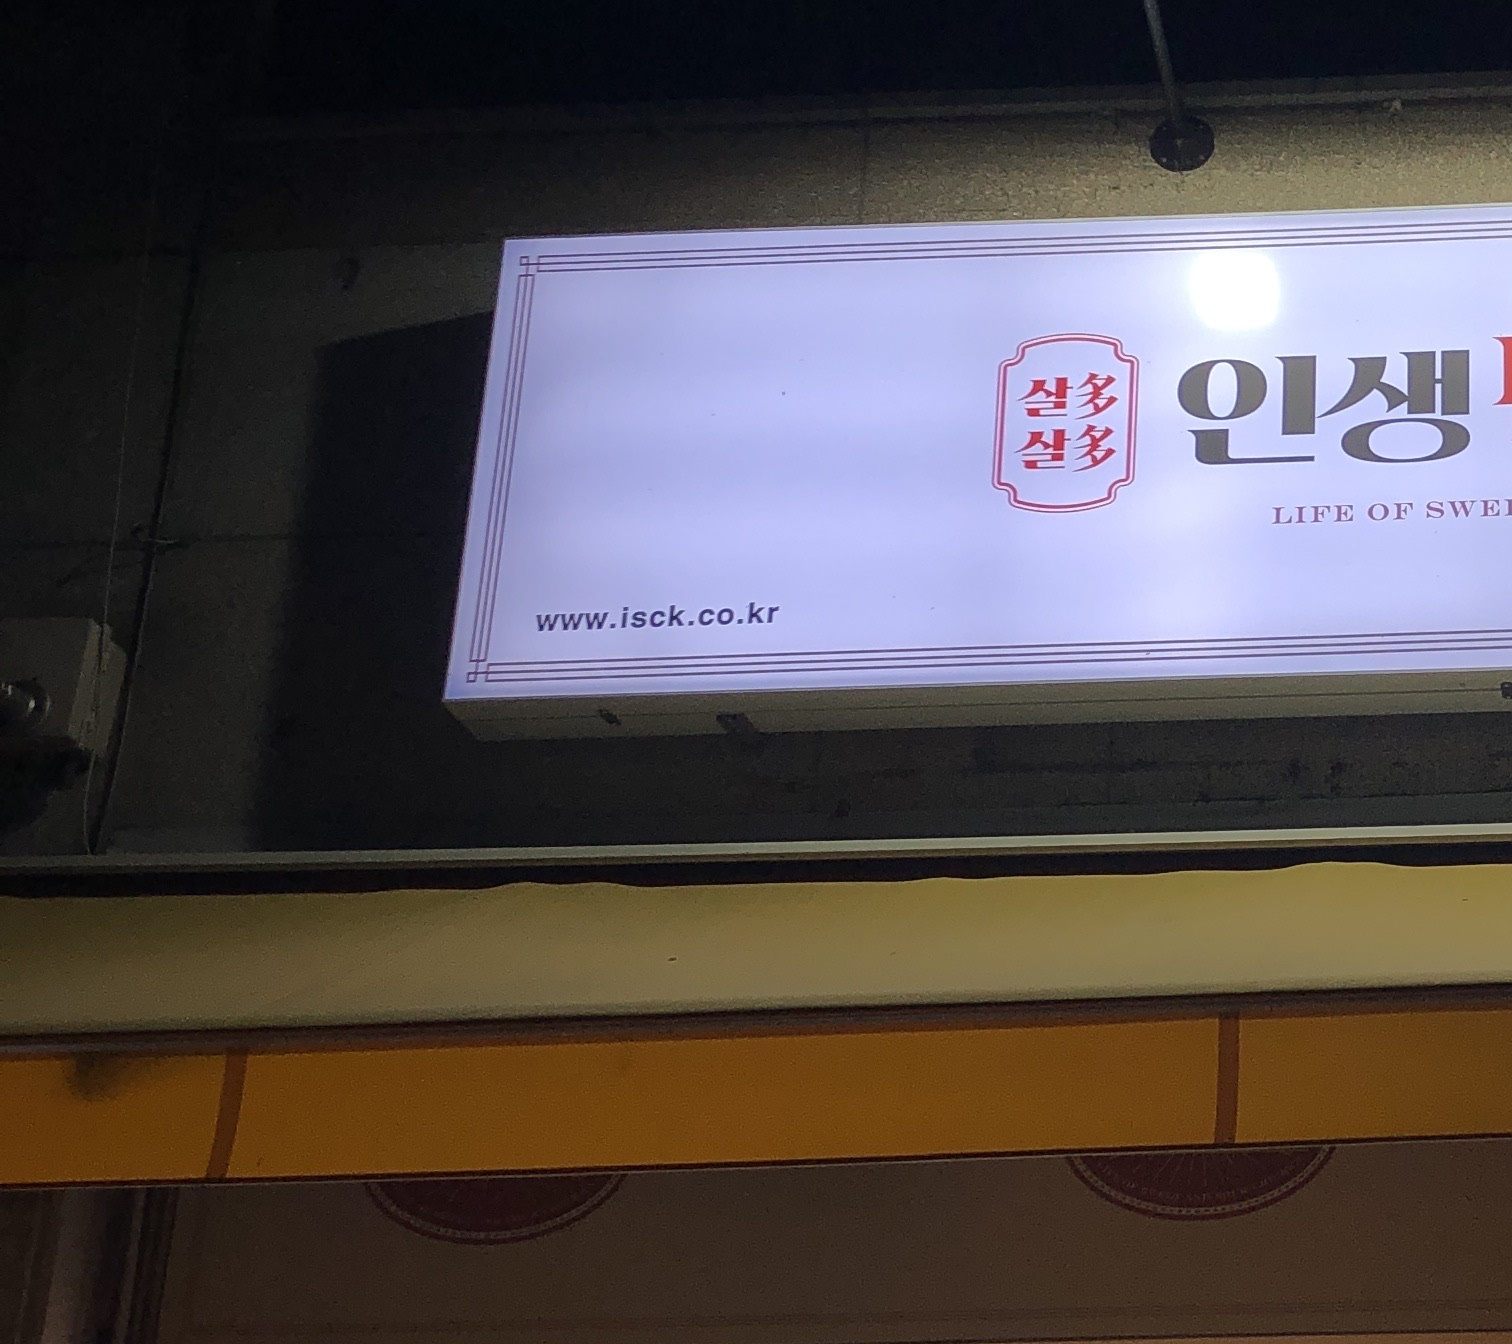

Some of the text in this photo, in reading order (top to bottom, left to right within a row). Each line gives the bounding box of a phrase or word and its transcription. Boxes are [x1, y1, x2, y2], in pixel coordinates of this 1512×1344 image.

[1272, 504, 1354, 525] LIFE
[1368, 502, 1414, 522] OF
[536, 602, 780, 632] www.isck.co.kr
